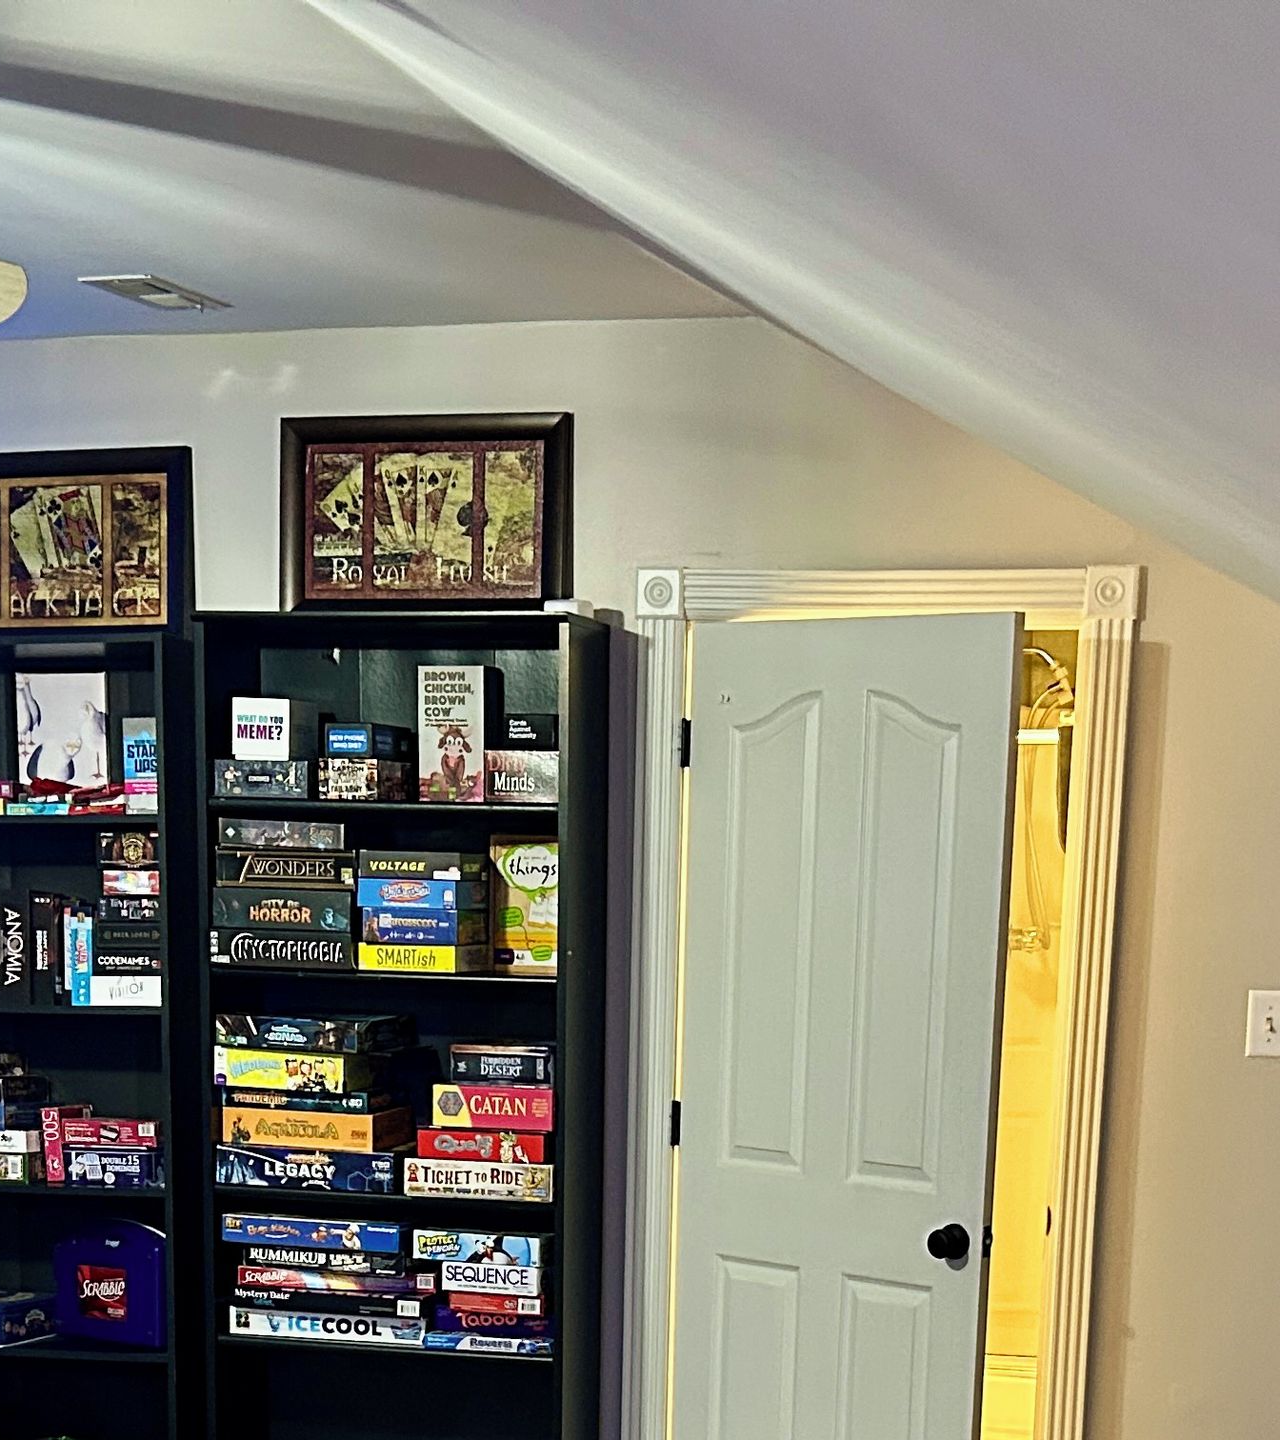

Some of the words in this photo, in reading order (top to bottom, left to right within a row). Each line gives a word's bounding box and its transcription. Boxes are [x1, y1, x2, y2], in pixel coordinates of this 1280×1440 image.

[423, 671, 466, 682] BROWN
[423, 683, 475, 695] CHICKEN,
[423, 695, 466, 705] BROWN
[236, 714, 257, 723] WHAT
[258, 714, 268, 724] DO
[270, 716, 284, 725] YOU
[423, 707, 452, 717] COW
[236, 724, 284, 740] MEME?
[493, 771, 536, 793] Minds
[250, 859, 336, 877] WONDERS
[369, 861, 426, 872] VOLTAGE
[509, 854, 557, 885] things
[260, 899, 285, 908] CITY
[249, 905, 312, 924] HORROR
[3, 907, 24, 986] ANOMIA
[97, 955, 151, 967] CODENAMES
[376, 947, 437, 968] SMARTish
[480, 1064, 523, 1077] DESERT
[470, 1095, 527, 1116] CATAN
[41, 1109, 59, 1141] 500
[101, 1156, 127, 1165] DOUBLE
[127, 1155, 140, 1166] 15
[264, 1161, 337, 1181] LEGACY
[421, 1165, 472, 1185] TICKET
[474, 1172, 488, 1184] TO
[490, 1168, 525, 1187] RIDE
[249, 1248, 327, 1265] RUMMIKUB
[445, 1264, 529, 1287] SEQUENCE
[80, 1279, 126, 1301] SCRABBLE
[234, 1288, 269, 1300] Mystery
[269, 1290, 290, 1300] Date
